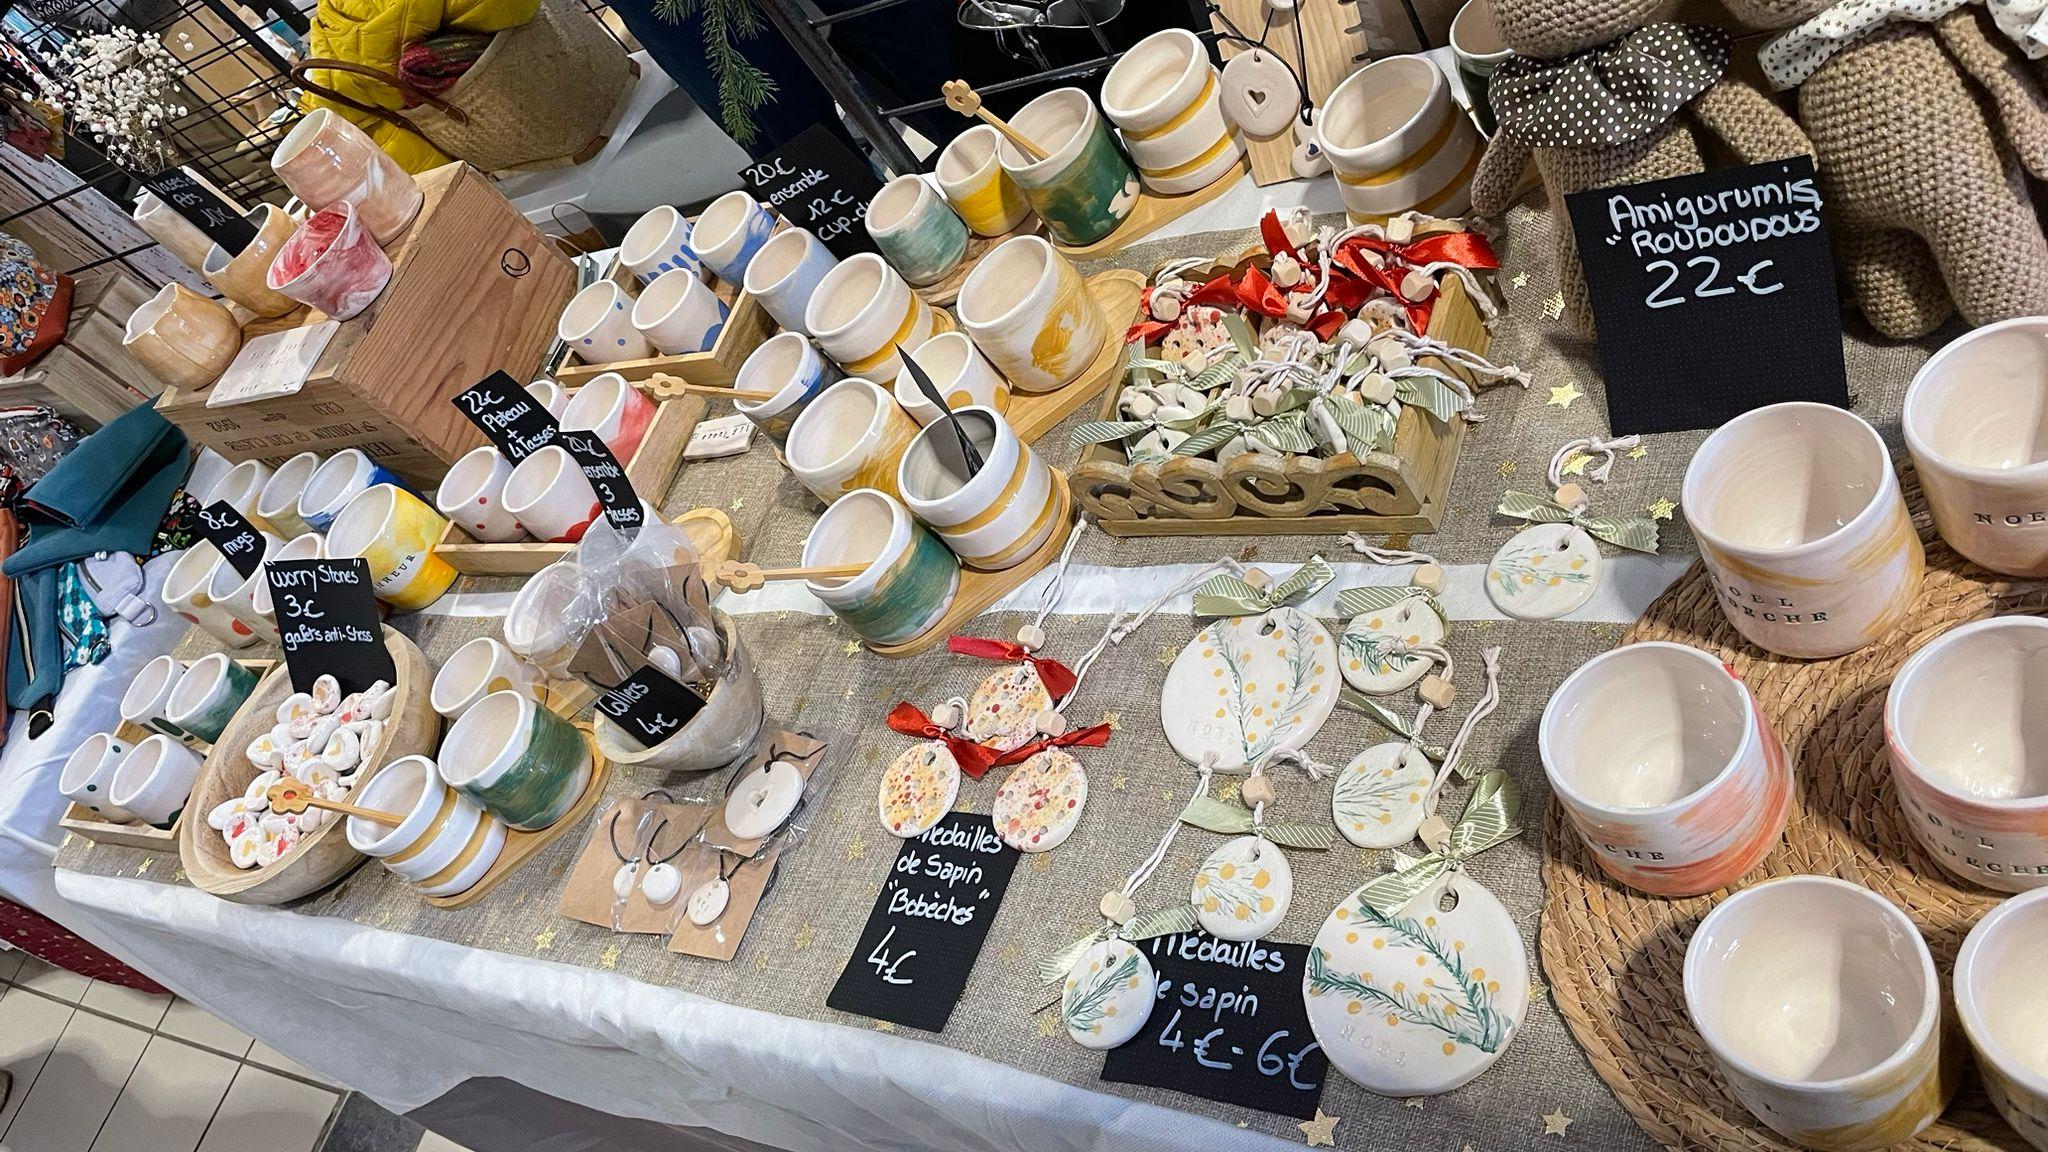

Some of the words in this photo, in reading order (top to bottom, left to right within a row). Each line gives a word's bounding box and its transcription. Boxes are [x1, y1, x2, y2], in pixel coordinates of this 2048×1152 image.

[769, 168, 830, 206] ensemble
[1608, 166, 1817, 233] Amigurumis
[1645, 255, 1785, 309] 22€
[481, 400, 532, 433] Plateau
[598, 482, 616, 503] 3
[222, 531, 256, 556] mugs
[896, 849, 922, 876] de
[867, 925, 917, 986] 4€
